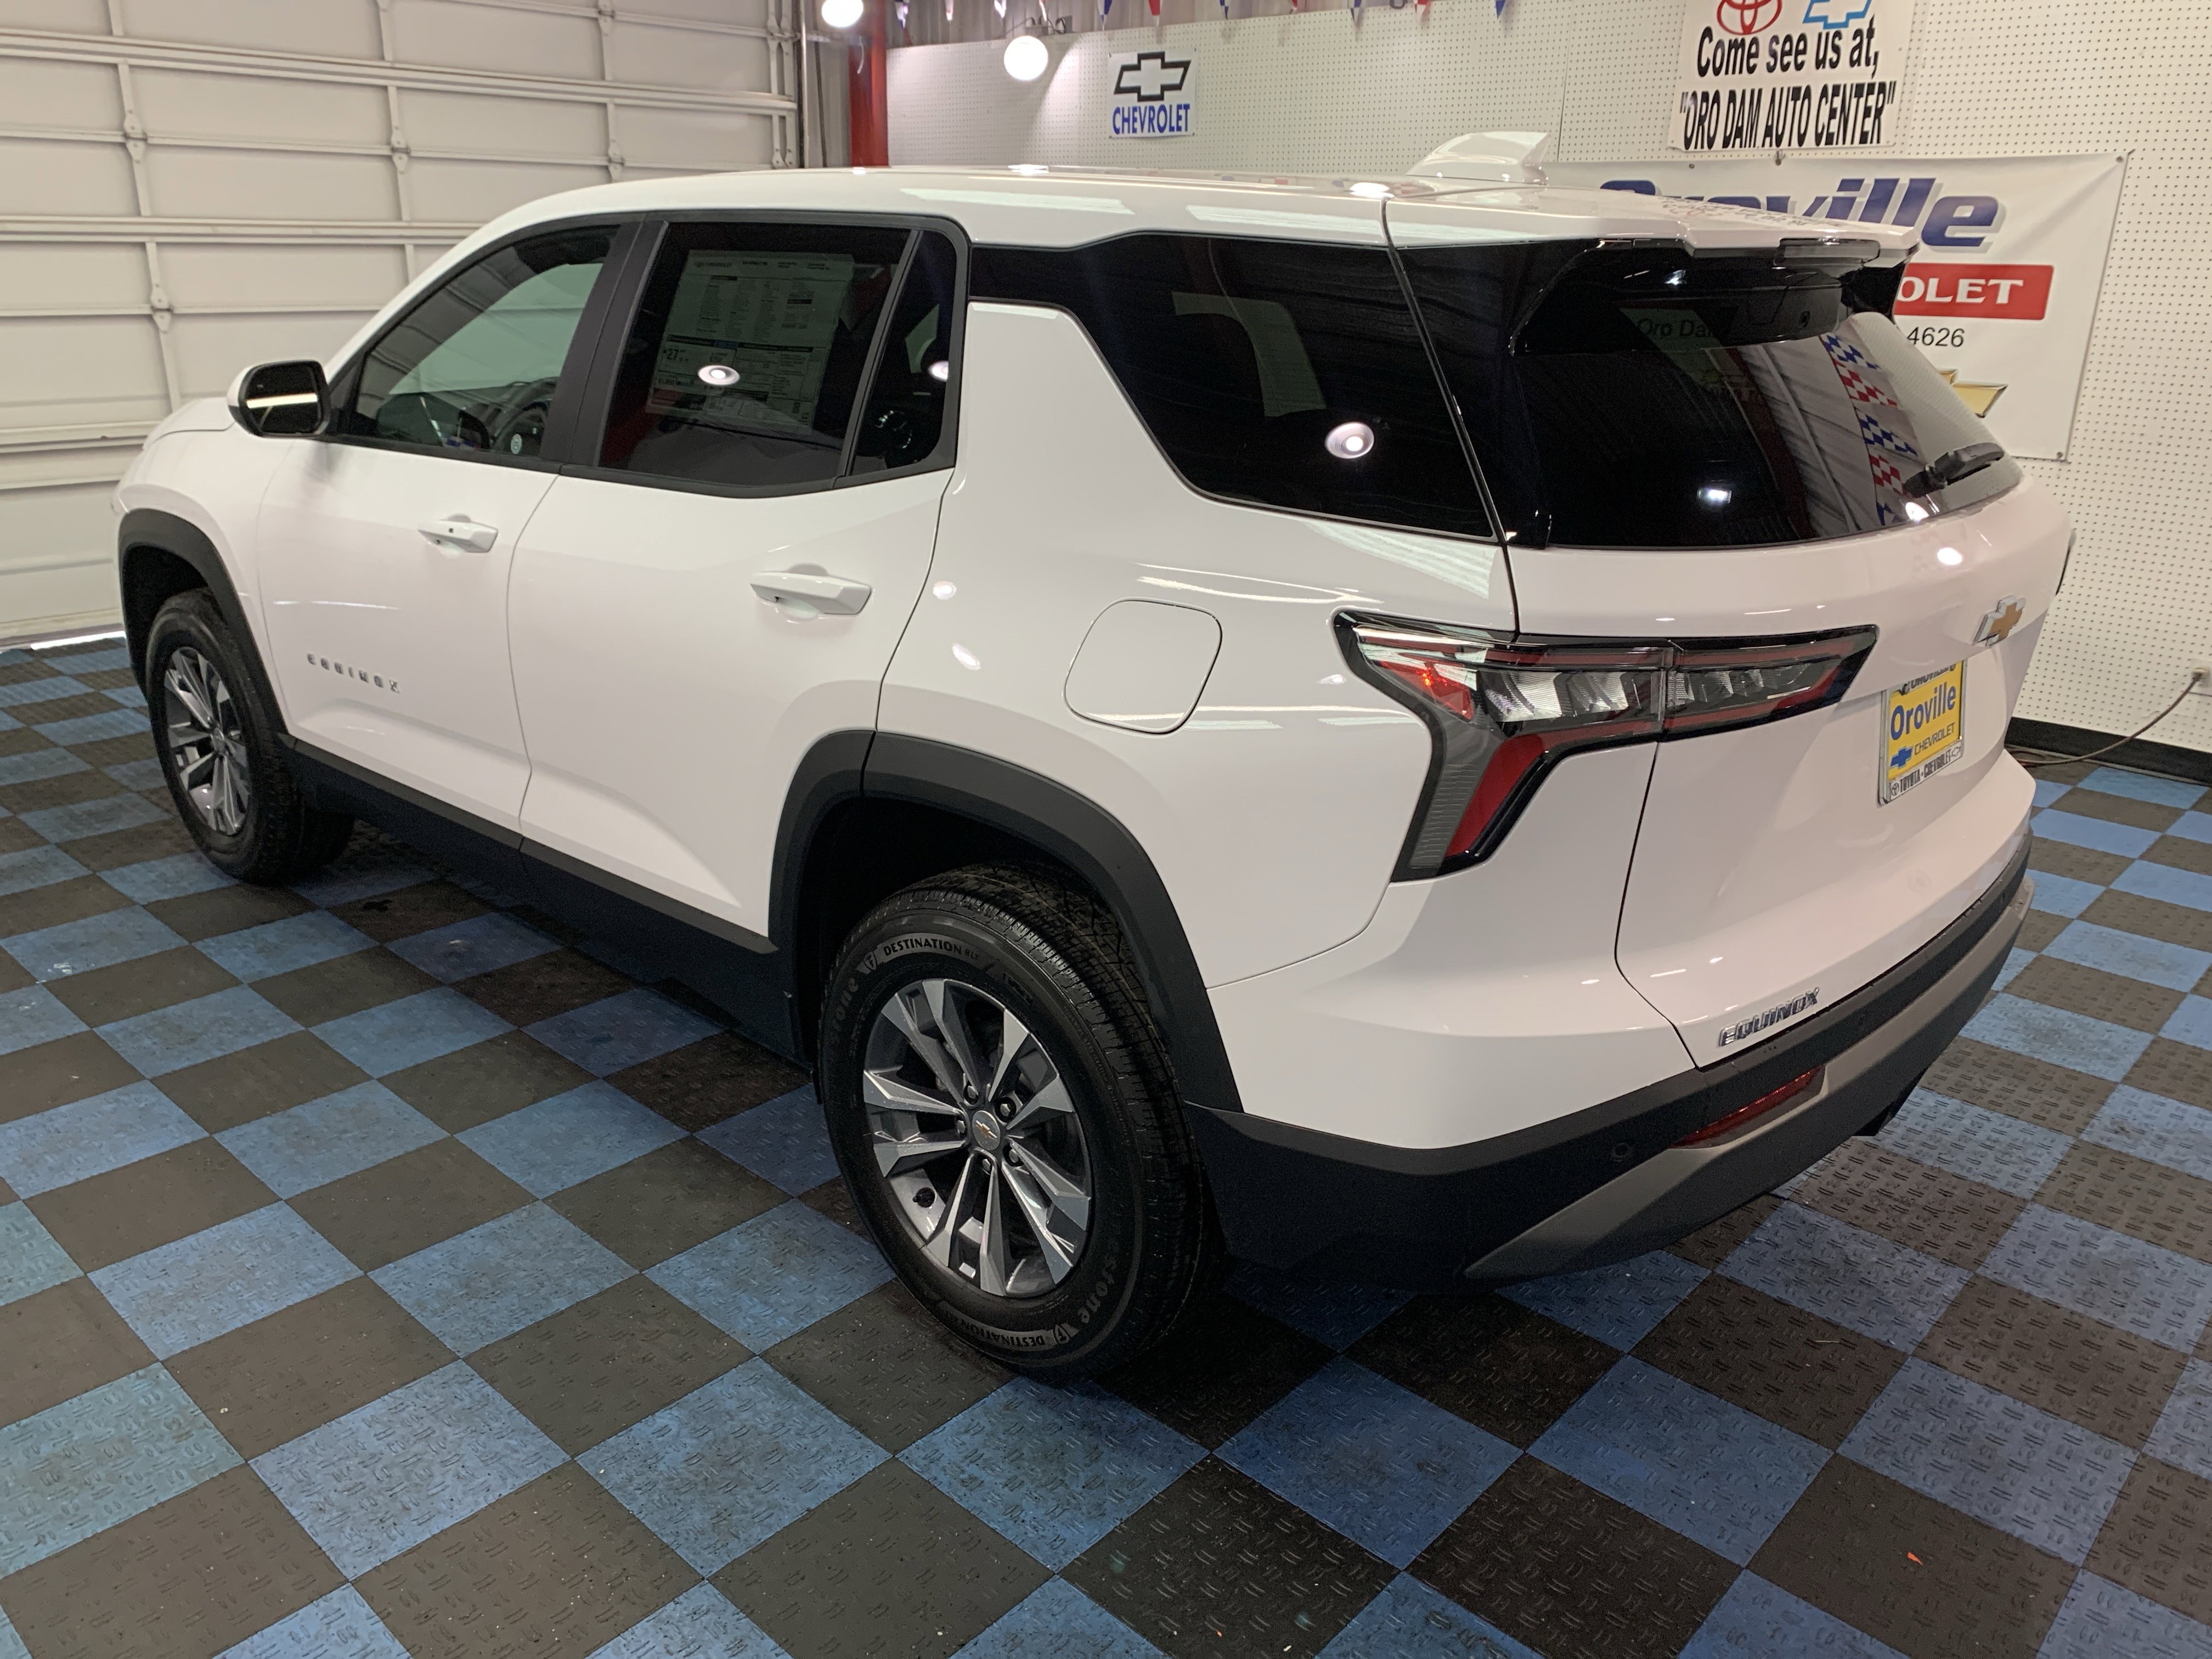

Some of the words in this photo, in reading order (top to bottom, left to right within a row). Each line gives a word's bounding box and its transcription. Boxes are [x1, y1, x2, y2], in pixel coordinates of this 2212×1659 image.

[1697, 26, 1759, 77] Come
[1766, 32, 1808, 73] see
[1815, 29, 1841, 70] us
[1849, 14, 1880, 79] at,
[1112, 104, 1190, 135] CHEVROLET
[1680, 89, 1721, 150] "ORO
[1722, 87, 1763, 149] DAM
[1762, 84, 1812, 148] AUTO
[1814, 81, 1897, 146] CENTER"
[1638, 318, 1672, 336] Oro
[1891, 681, 1956, 741] Oroville
[1914, 721, 1955, 756] CHEVROLET
[1900, 768, 1921, 793] TOYOTA
[1923, 748, 1952, 778] CHEVROLET
[883, 937, 963, 956] DESTINATION
[1718, 986, 1820, 1047] EQUINOX
